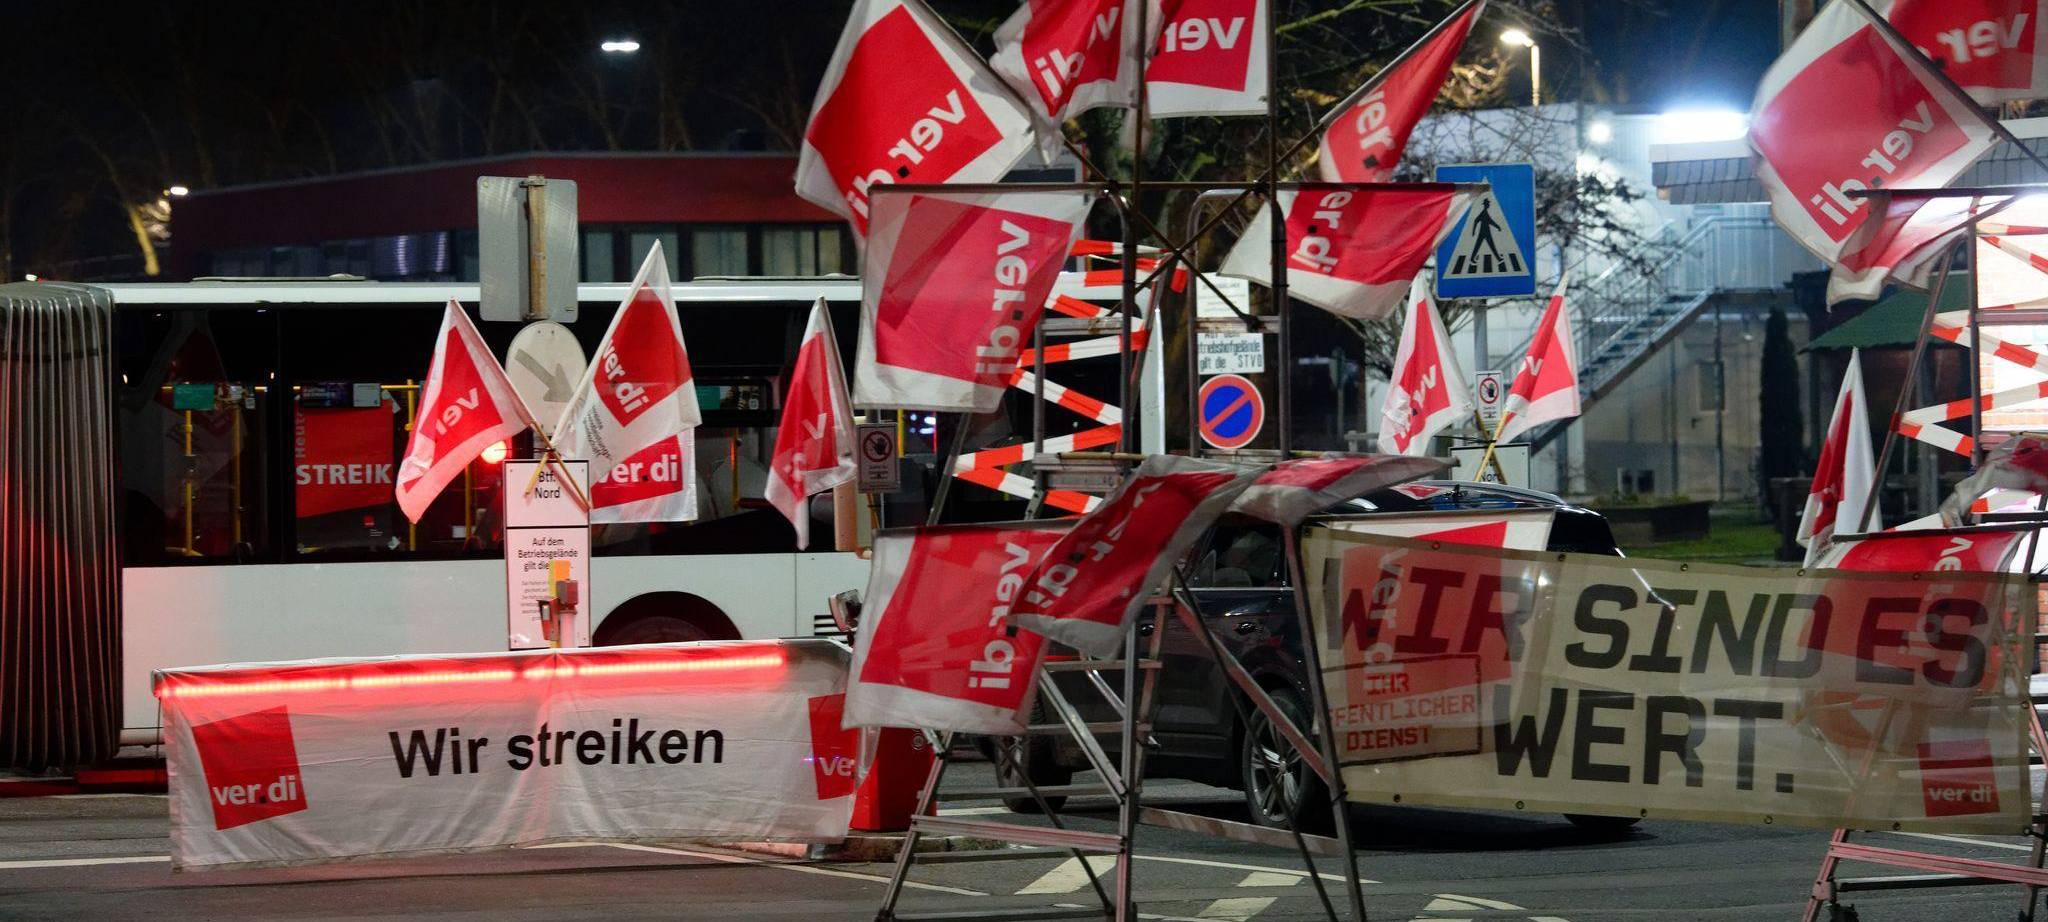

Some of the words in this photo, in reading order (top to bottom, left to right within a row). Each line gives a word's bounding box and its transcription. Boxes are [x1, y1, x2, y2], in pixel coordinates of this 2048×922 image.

[295, 463, 392, 485] STREIK
[535, 487, 561, 499] Nord
[518, 549, 578, 560] Betriebsgelände
[532, 537, 546, 546] Auf
[548, 537, 564, 546] dem
[1323, 558, 1536, 662] WIR
[1565, 583, 1833, 679] SIND
[1855, 597, 1989, 690] ES
[1332, 694, 1476, 727] FENTLICHER
[388, 727, 489, 779] Wir
[507, 718, 724, 772] streiken
[1346, 724, 1431, 751] DIENST
[1493, 684, 1795, 795] WERT.
[213, 775, 298, 807] ver.di
